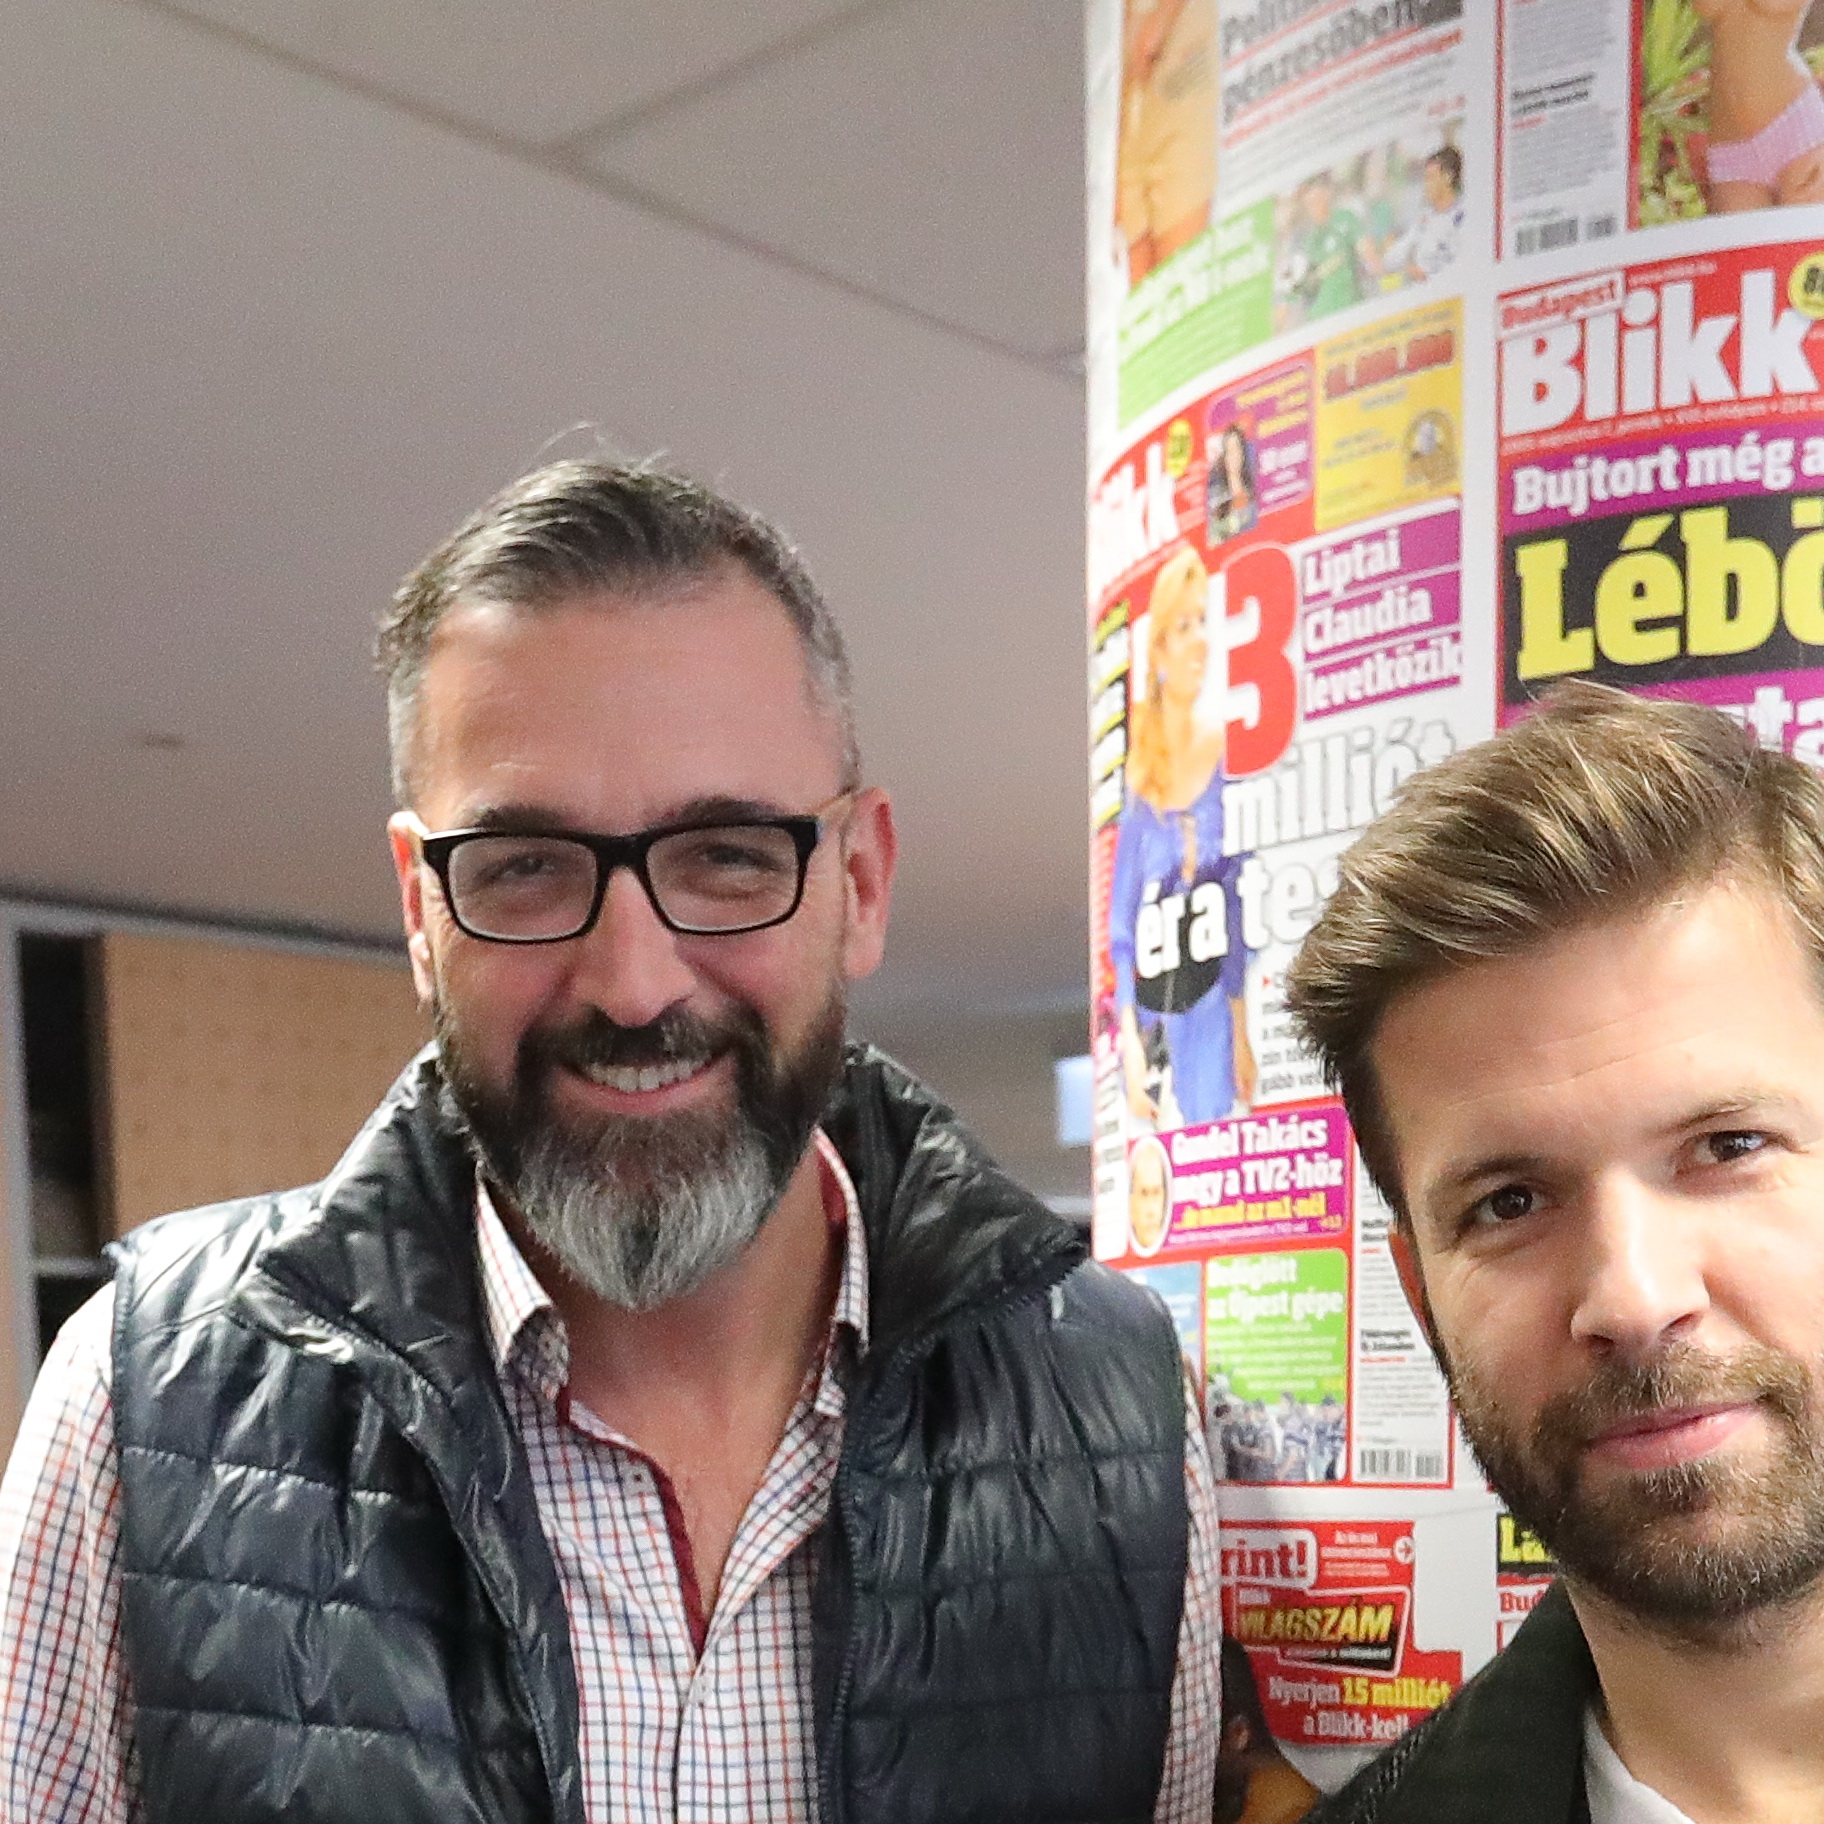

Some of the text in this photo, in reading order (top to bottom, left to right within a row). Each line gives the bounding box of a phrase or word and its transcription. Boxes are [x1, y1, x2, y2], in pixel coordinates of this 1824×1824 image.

[1500, 279, 1619, 329] Budapest
[1502, 267, 1820, 436] Blikk
[1512, 444, 1680, 517] Bujtort
[1685, 431, 1796, 490] még
[1302, 530, 1401, 597] Liptai
[1304, 588, 1432, 654] Claudia
[1221, 543, 1297, 777] 3
[1241, 1114, 1328, 1155] Takács
[1241, 1153, 1343, 1194] TV2-höz
[1268, 1676, 1452, 1710] Nyerjen 15 milliót
[1303, 1715, 1315, 1735] a
